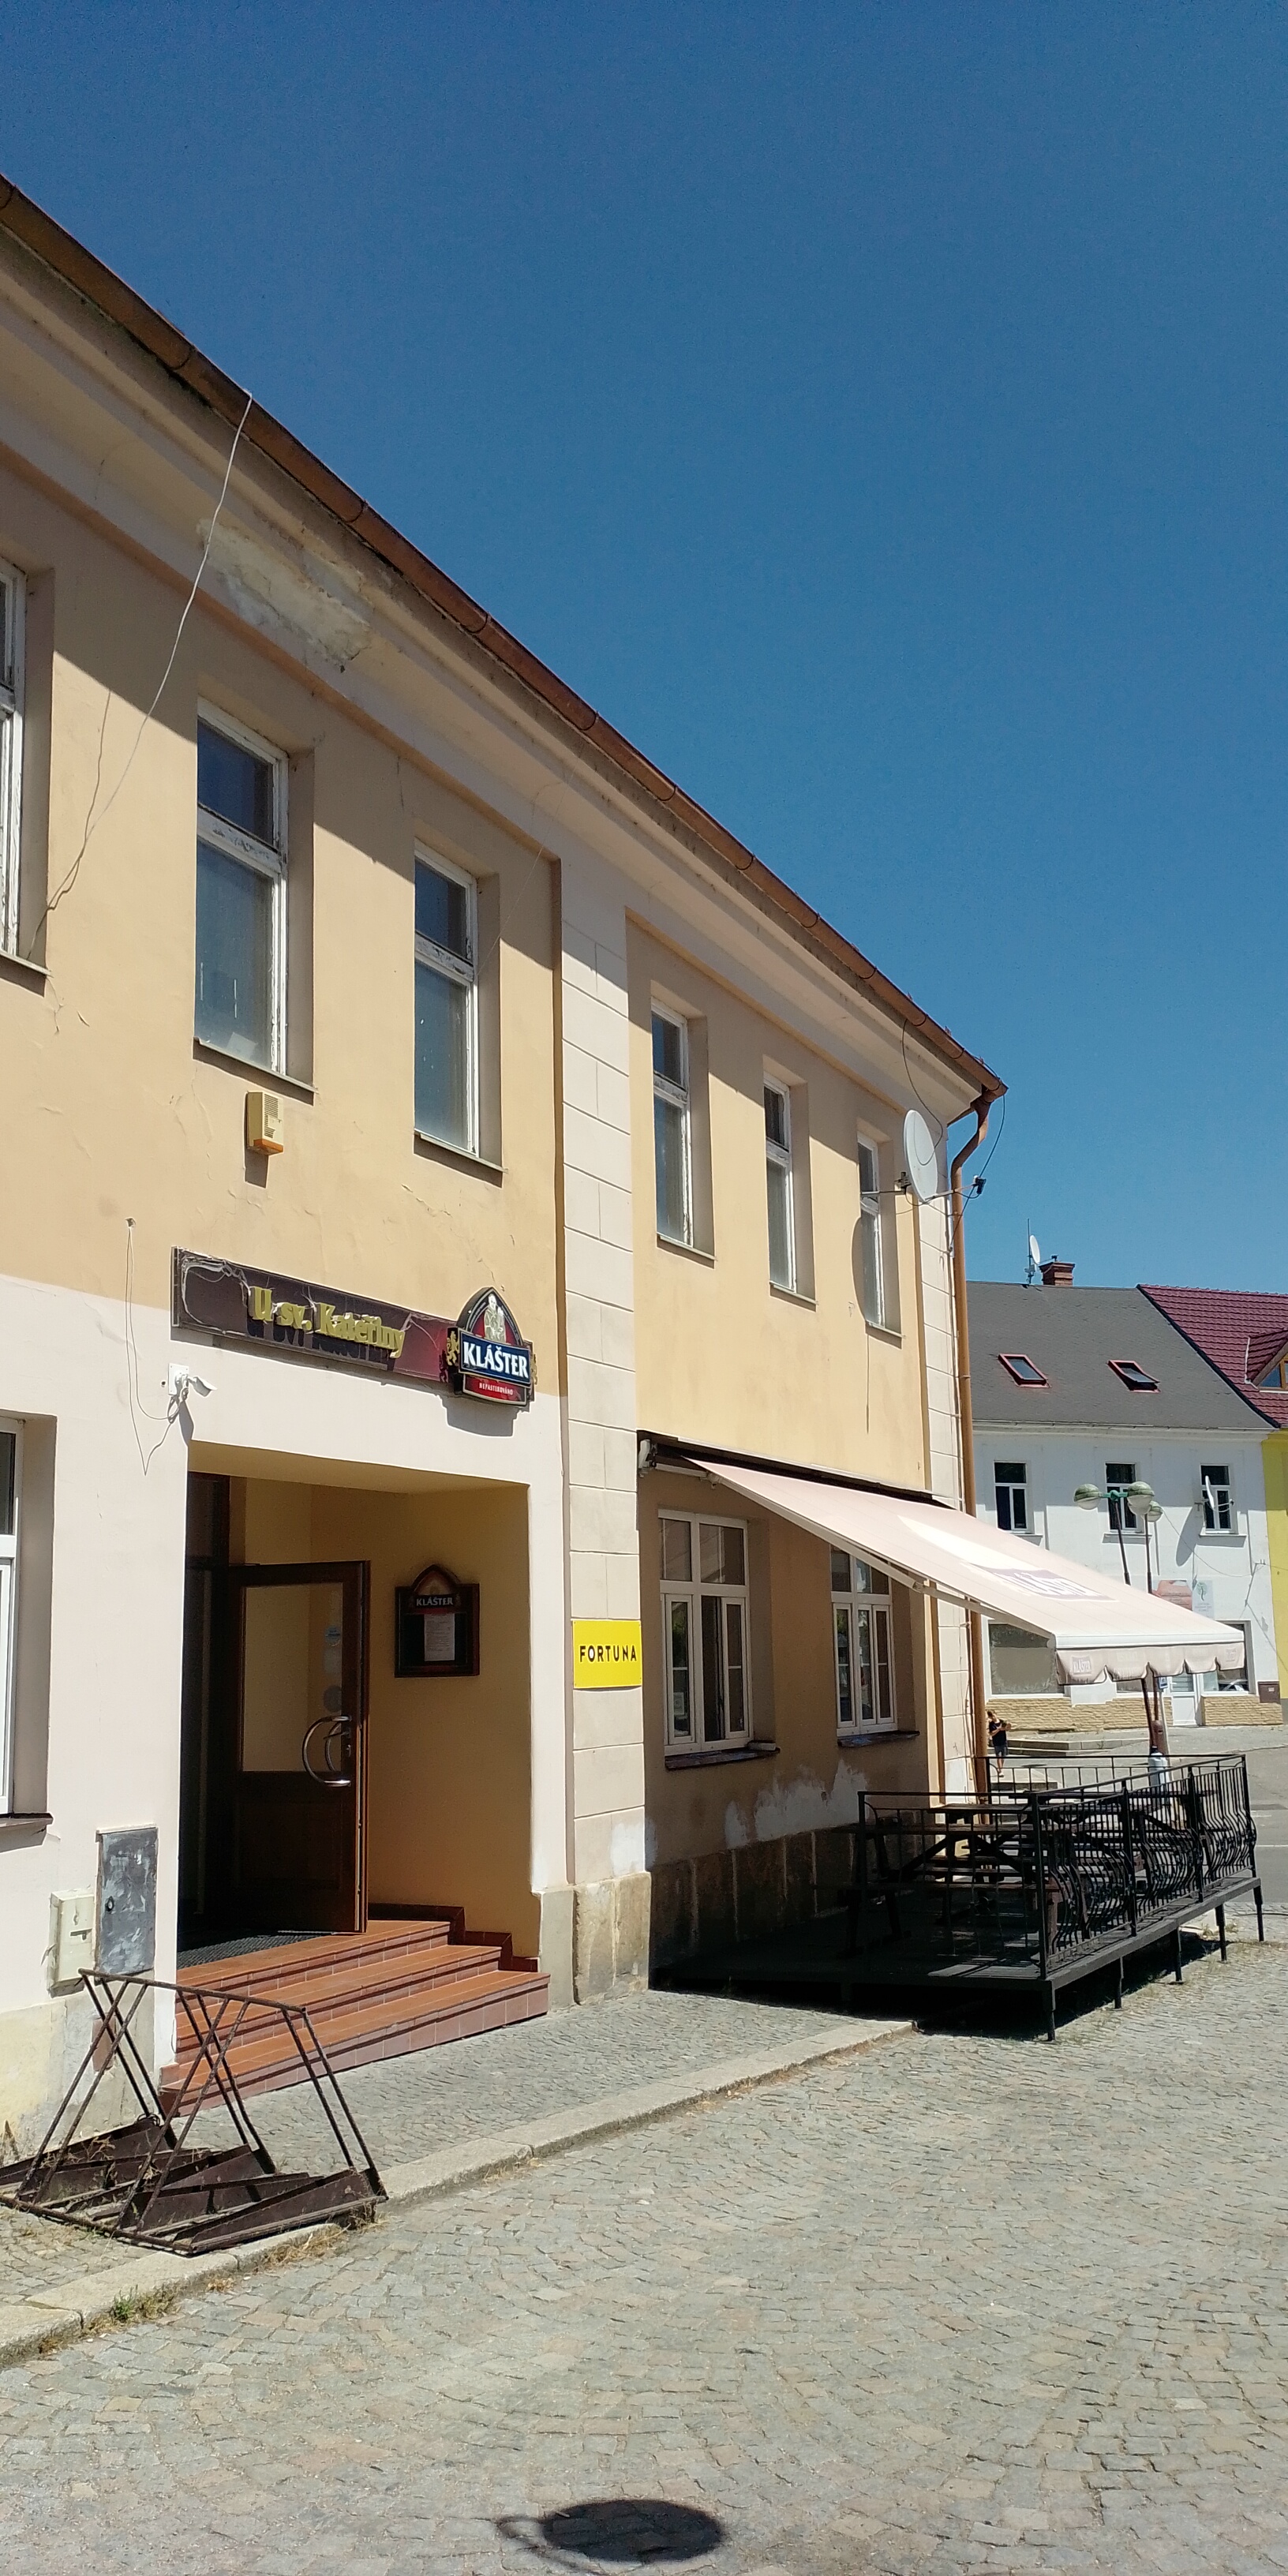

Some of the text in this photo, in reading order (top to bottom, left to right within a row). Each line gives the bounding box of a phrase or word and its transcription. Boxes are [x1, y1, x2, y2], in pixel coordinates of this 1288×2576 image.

[248, 1286, 406, 1359] U sv. Kateřiny
[462, 1341, 529, 1379] KLÁŠTER
[416, 1596, 454, 1606] KLÁŠTER
[579, 1645, 637, 1663] FORTUNA
